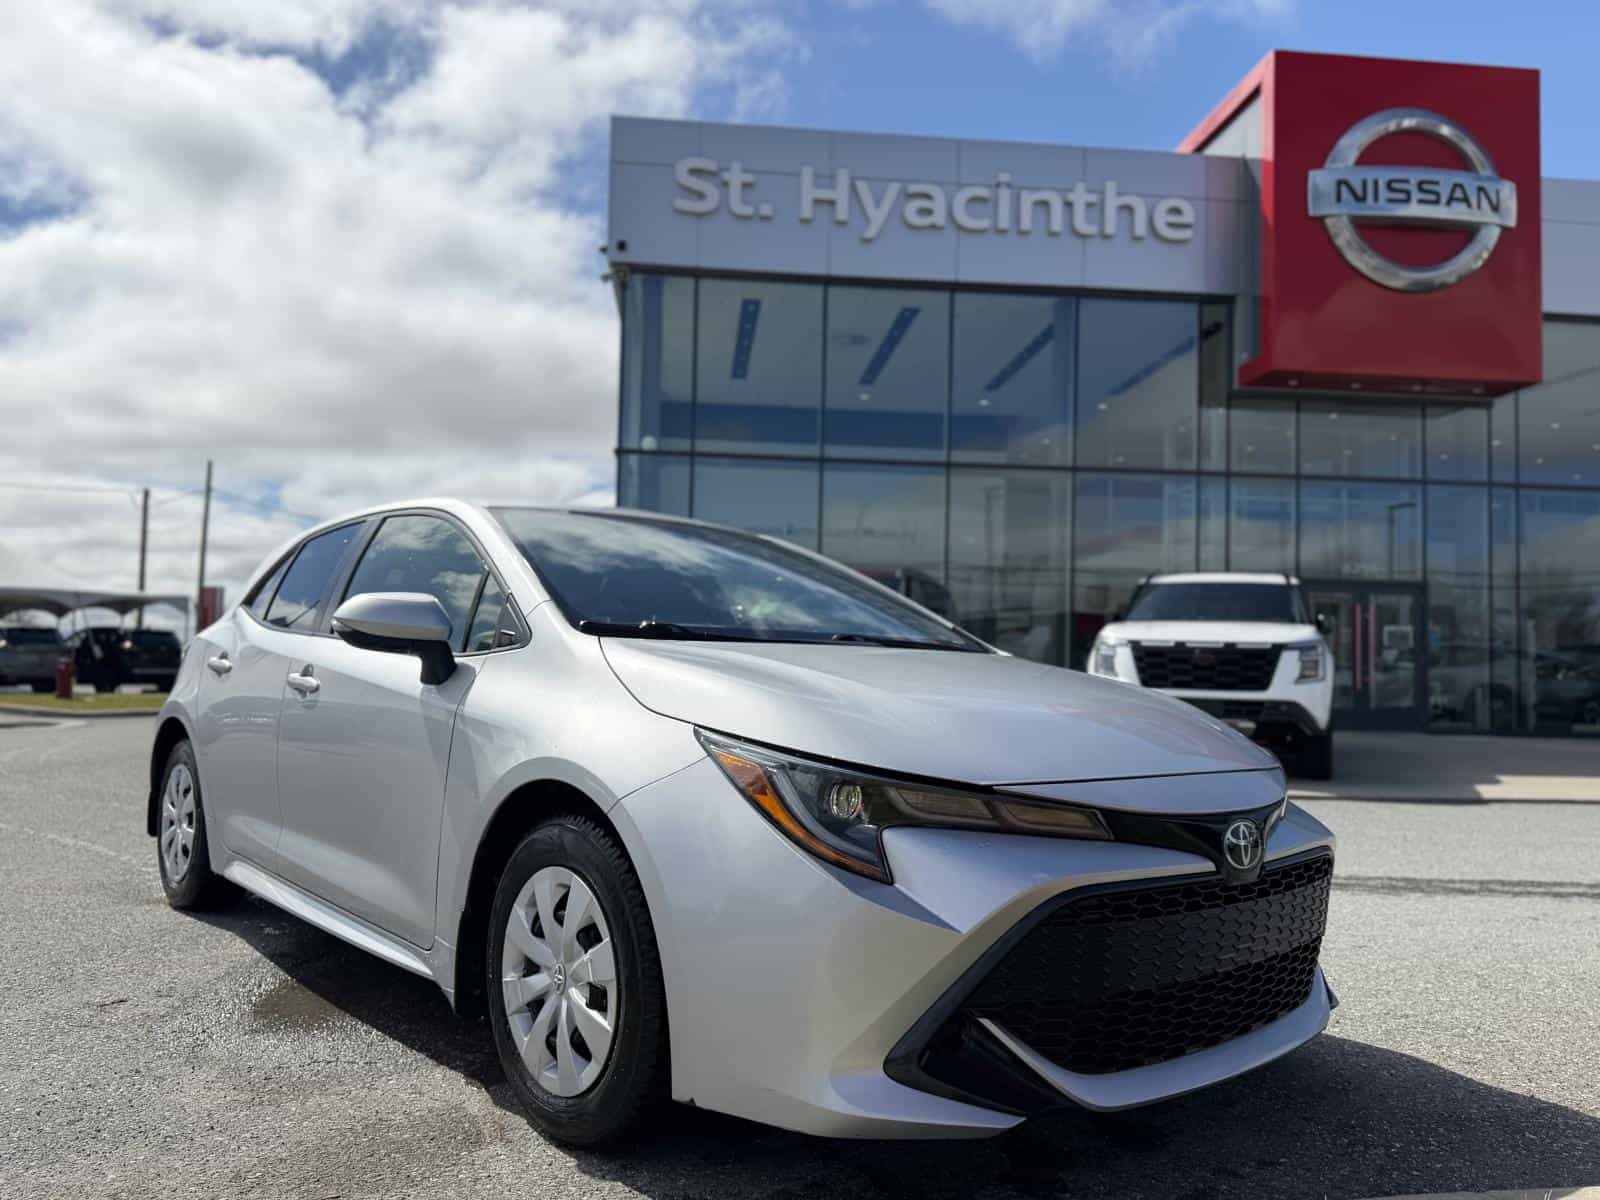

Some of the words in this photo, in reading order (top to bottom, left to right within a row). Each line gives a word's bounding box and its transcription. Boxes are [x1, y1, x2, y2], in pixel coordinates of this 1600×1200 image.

[672, 157, 774, 219] St.
[799, 164, 1197, 243] Hyacinthe
[1335, 178, 1501, 214] NISSAN
